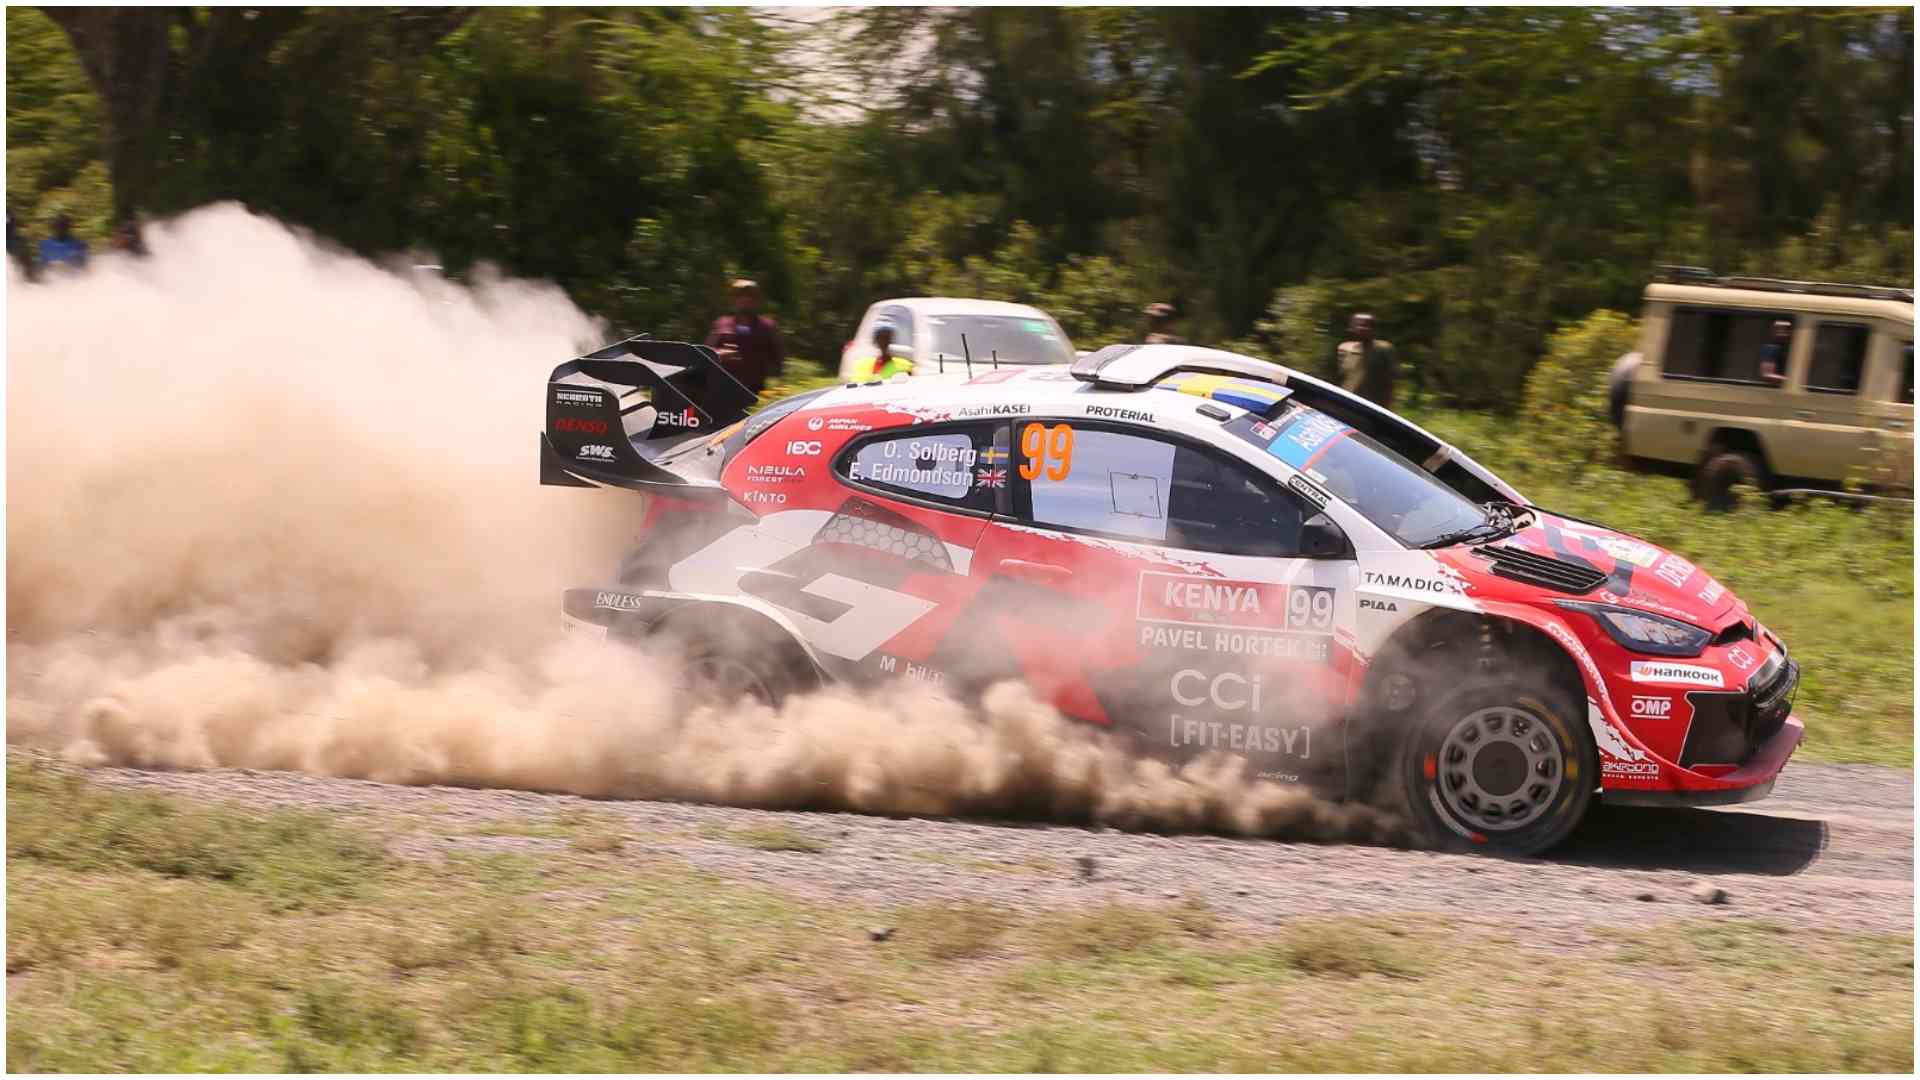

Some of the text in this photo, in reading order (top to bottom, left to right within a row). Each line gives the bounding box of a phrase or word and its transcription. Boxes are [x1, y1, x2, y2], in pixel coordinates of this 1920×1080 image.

[656, 407, 700, 428] Stilo
[959, 404, 1031, 417] AsahiKASEI
[1085, 404, 1157, 423] PROTERIAL
[884, 441, 977, 467] O. Solberg
[1018, 422, 1074, 482] 99
[848, 462, 974, 488] E. Edmondson
[1365, 572, 1445, 592] TAMADIC
[595, 591, 643, 609] ENDLESS
[1166, 582, 1262, 615] KENYA
[1290, 588, 1333, 628] 99
[1359, 599, 1398, 612] PIAA
[1140, 627, 1209, 650] PAVEL
[1214, 633, 1302, 658] HORTEK
[1170, 668, 1263, 713] CCi
[1631, 699, 1672, 715] OMP
[1170, 714, 1311, 759] [FIT-EASY]
